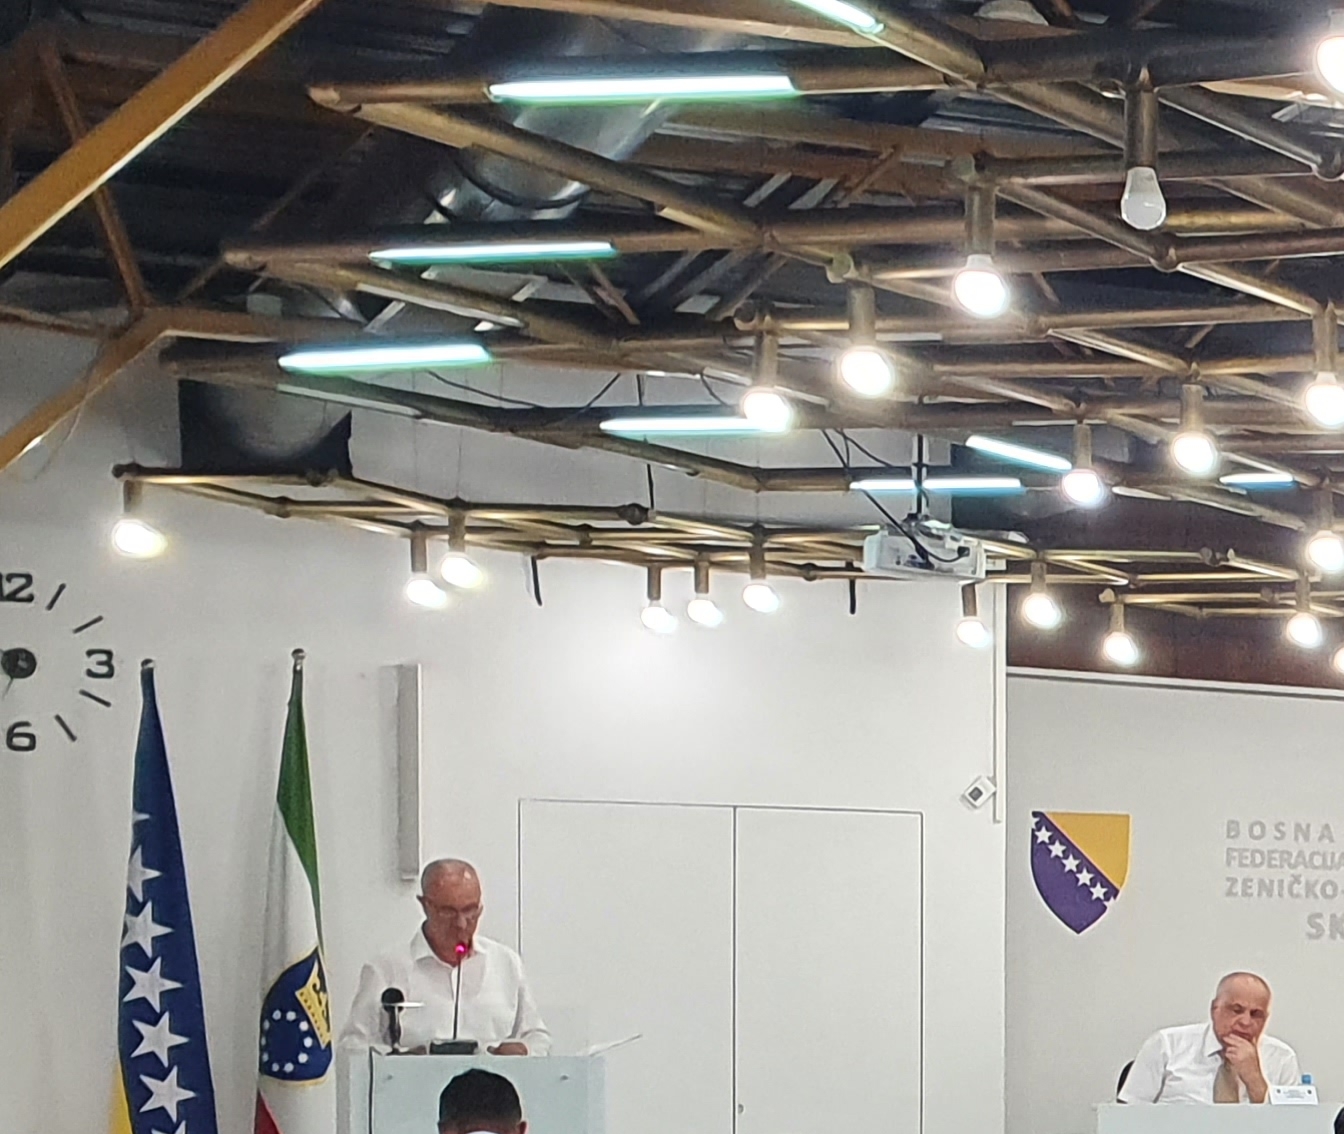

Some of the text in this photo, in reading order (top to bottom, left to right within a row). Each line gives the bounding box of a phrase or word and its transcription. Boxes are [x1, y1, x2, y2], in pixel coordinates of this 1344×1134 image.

[86, 649, 115, 679] 3
[6, 721, 37, 751] 6
[1226, 819, 1334, 843] BOSNA
